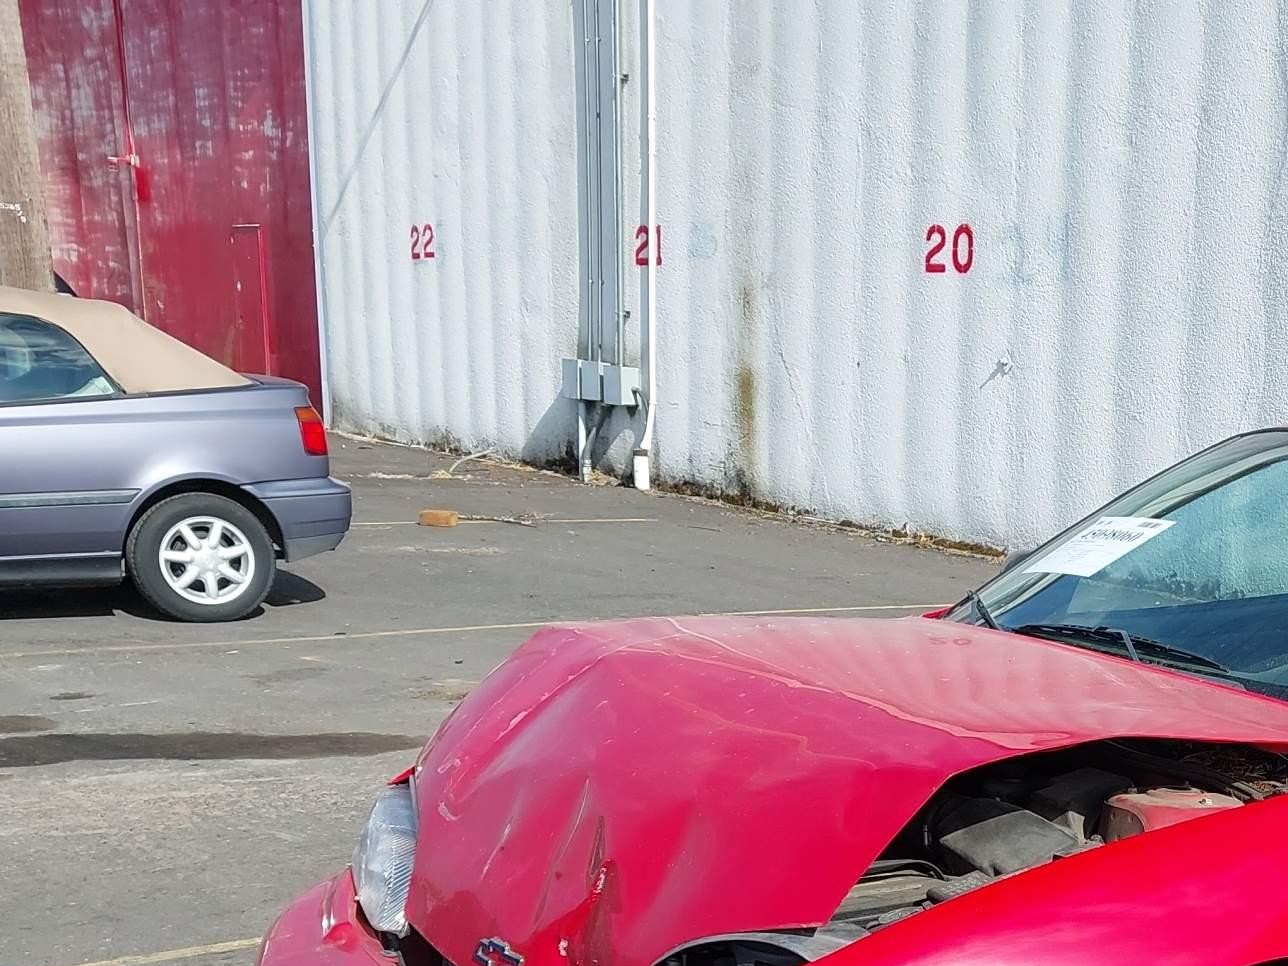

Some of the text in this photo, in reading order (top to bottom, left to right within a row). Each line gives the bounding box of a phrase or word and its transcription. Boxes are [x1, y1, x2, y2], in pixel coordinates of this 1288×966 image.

[410, 224, 435, 260] 22
[635, 225, 662, 266] 21
[925, 225, 974, 273] 20
